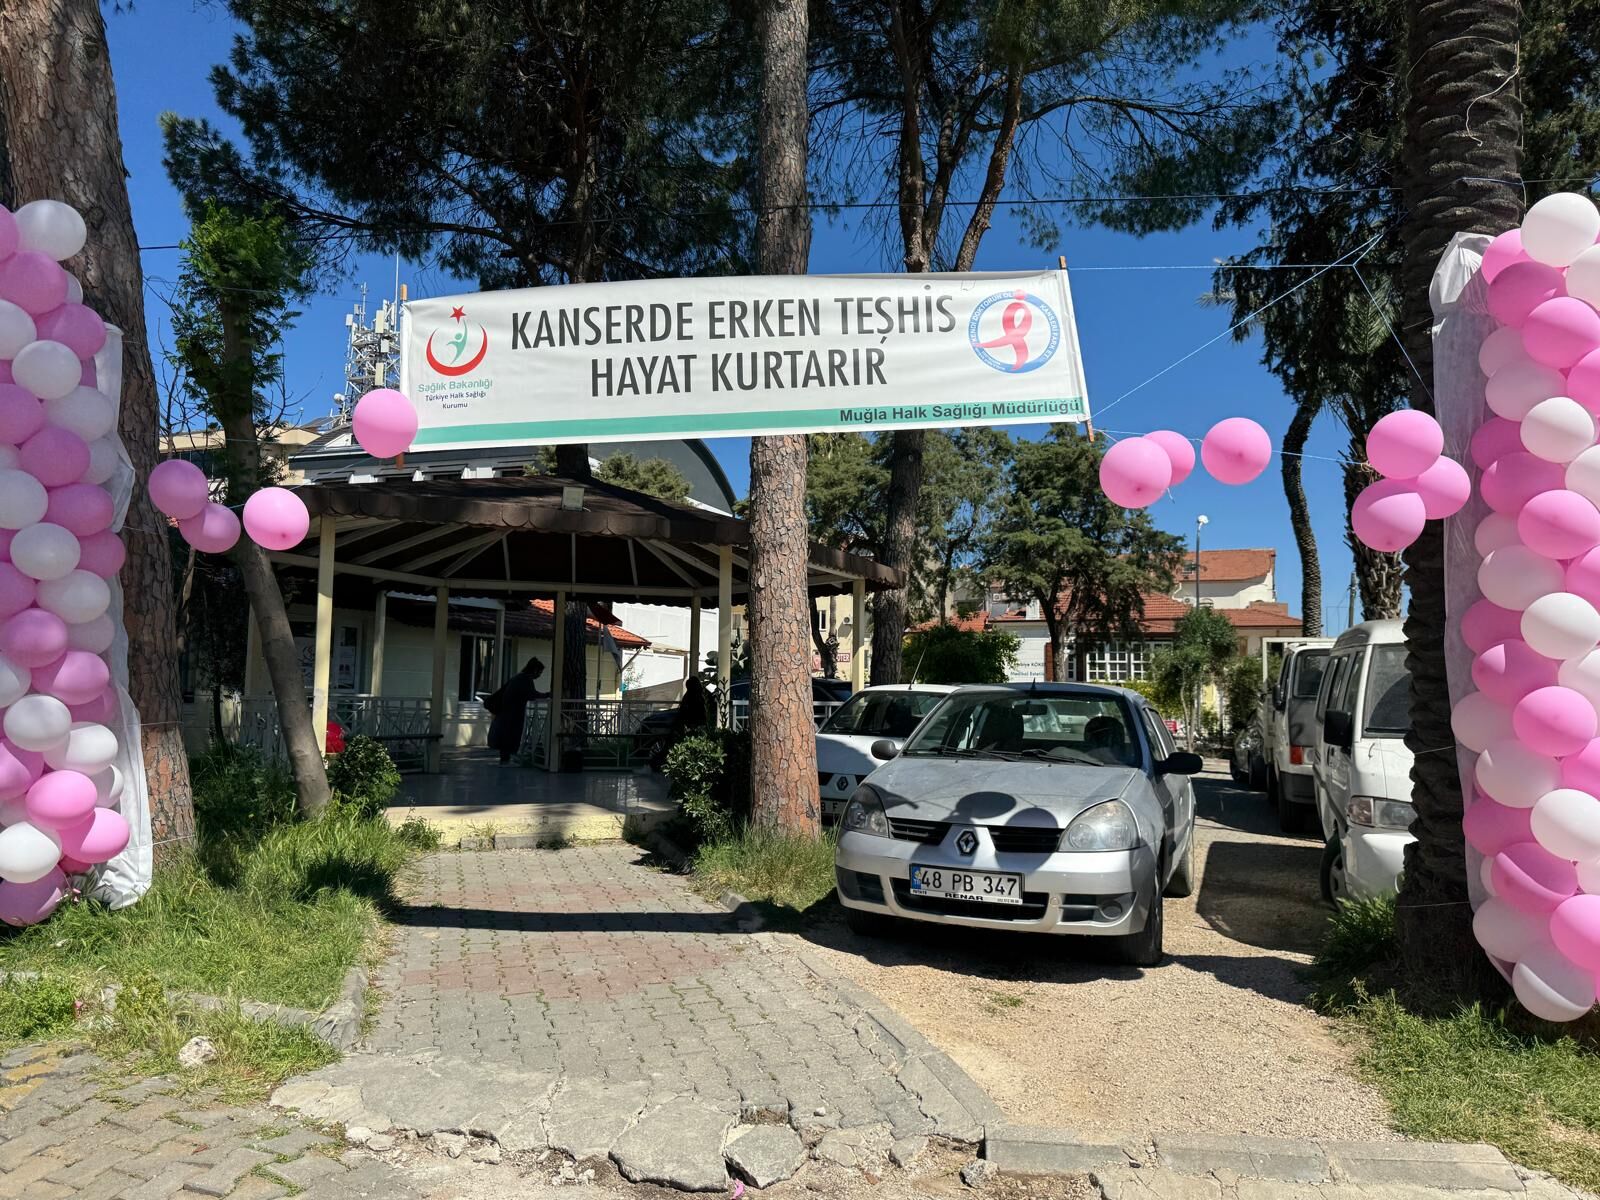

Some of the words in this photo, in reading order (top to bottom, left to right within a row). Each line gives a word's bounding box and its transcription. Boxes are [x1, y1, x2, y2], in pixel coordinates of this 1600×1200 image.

[511, 302, 694, 350] KANSERDE
[708, 298, 821, 340] ERKEN
[834, 284, 956, 344] TEŞHİS
[591, 354, 697, 397] HAYAT
[711, 348, 888, 392] KURTARIR
[418, 382, 447, 393] Sağlık
[449, 379, 493, 390] Bakanlığı
[425, 394, 449, 402] Türkiye
[466, 390, 486, 398] Sağlığı
[840, 408, 887, 424] Muğla
[893, 406, 927, 419] Halk
[932, 403, 986, 419] Sağlığı
[992, 399, 1080, 415] Müdürlüğü
[921, 870, 942, 889] 48
[952, 873, 974, 892] PB
[983, 875, 1017, 896] 347
[944, 892, 984, 901] RENAR
